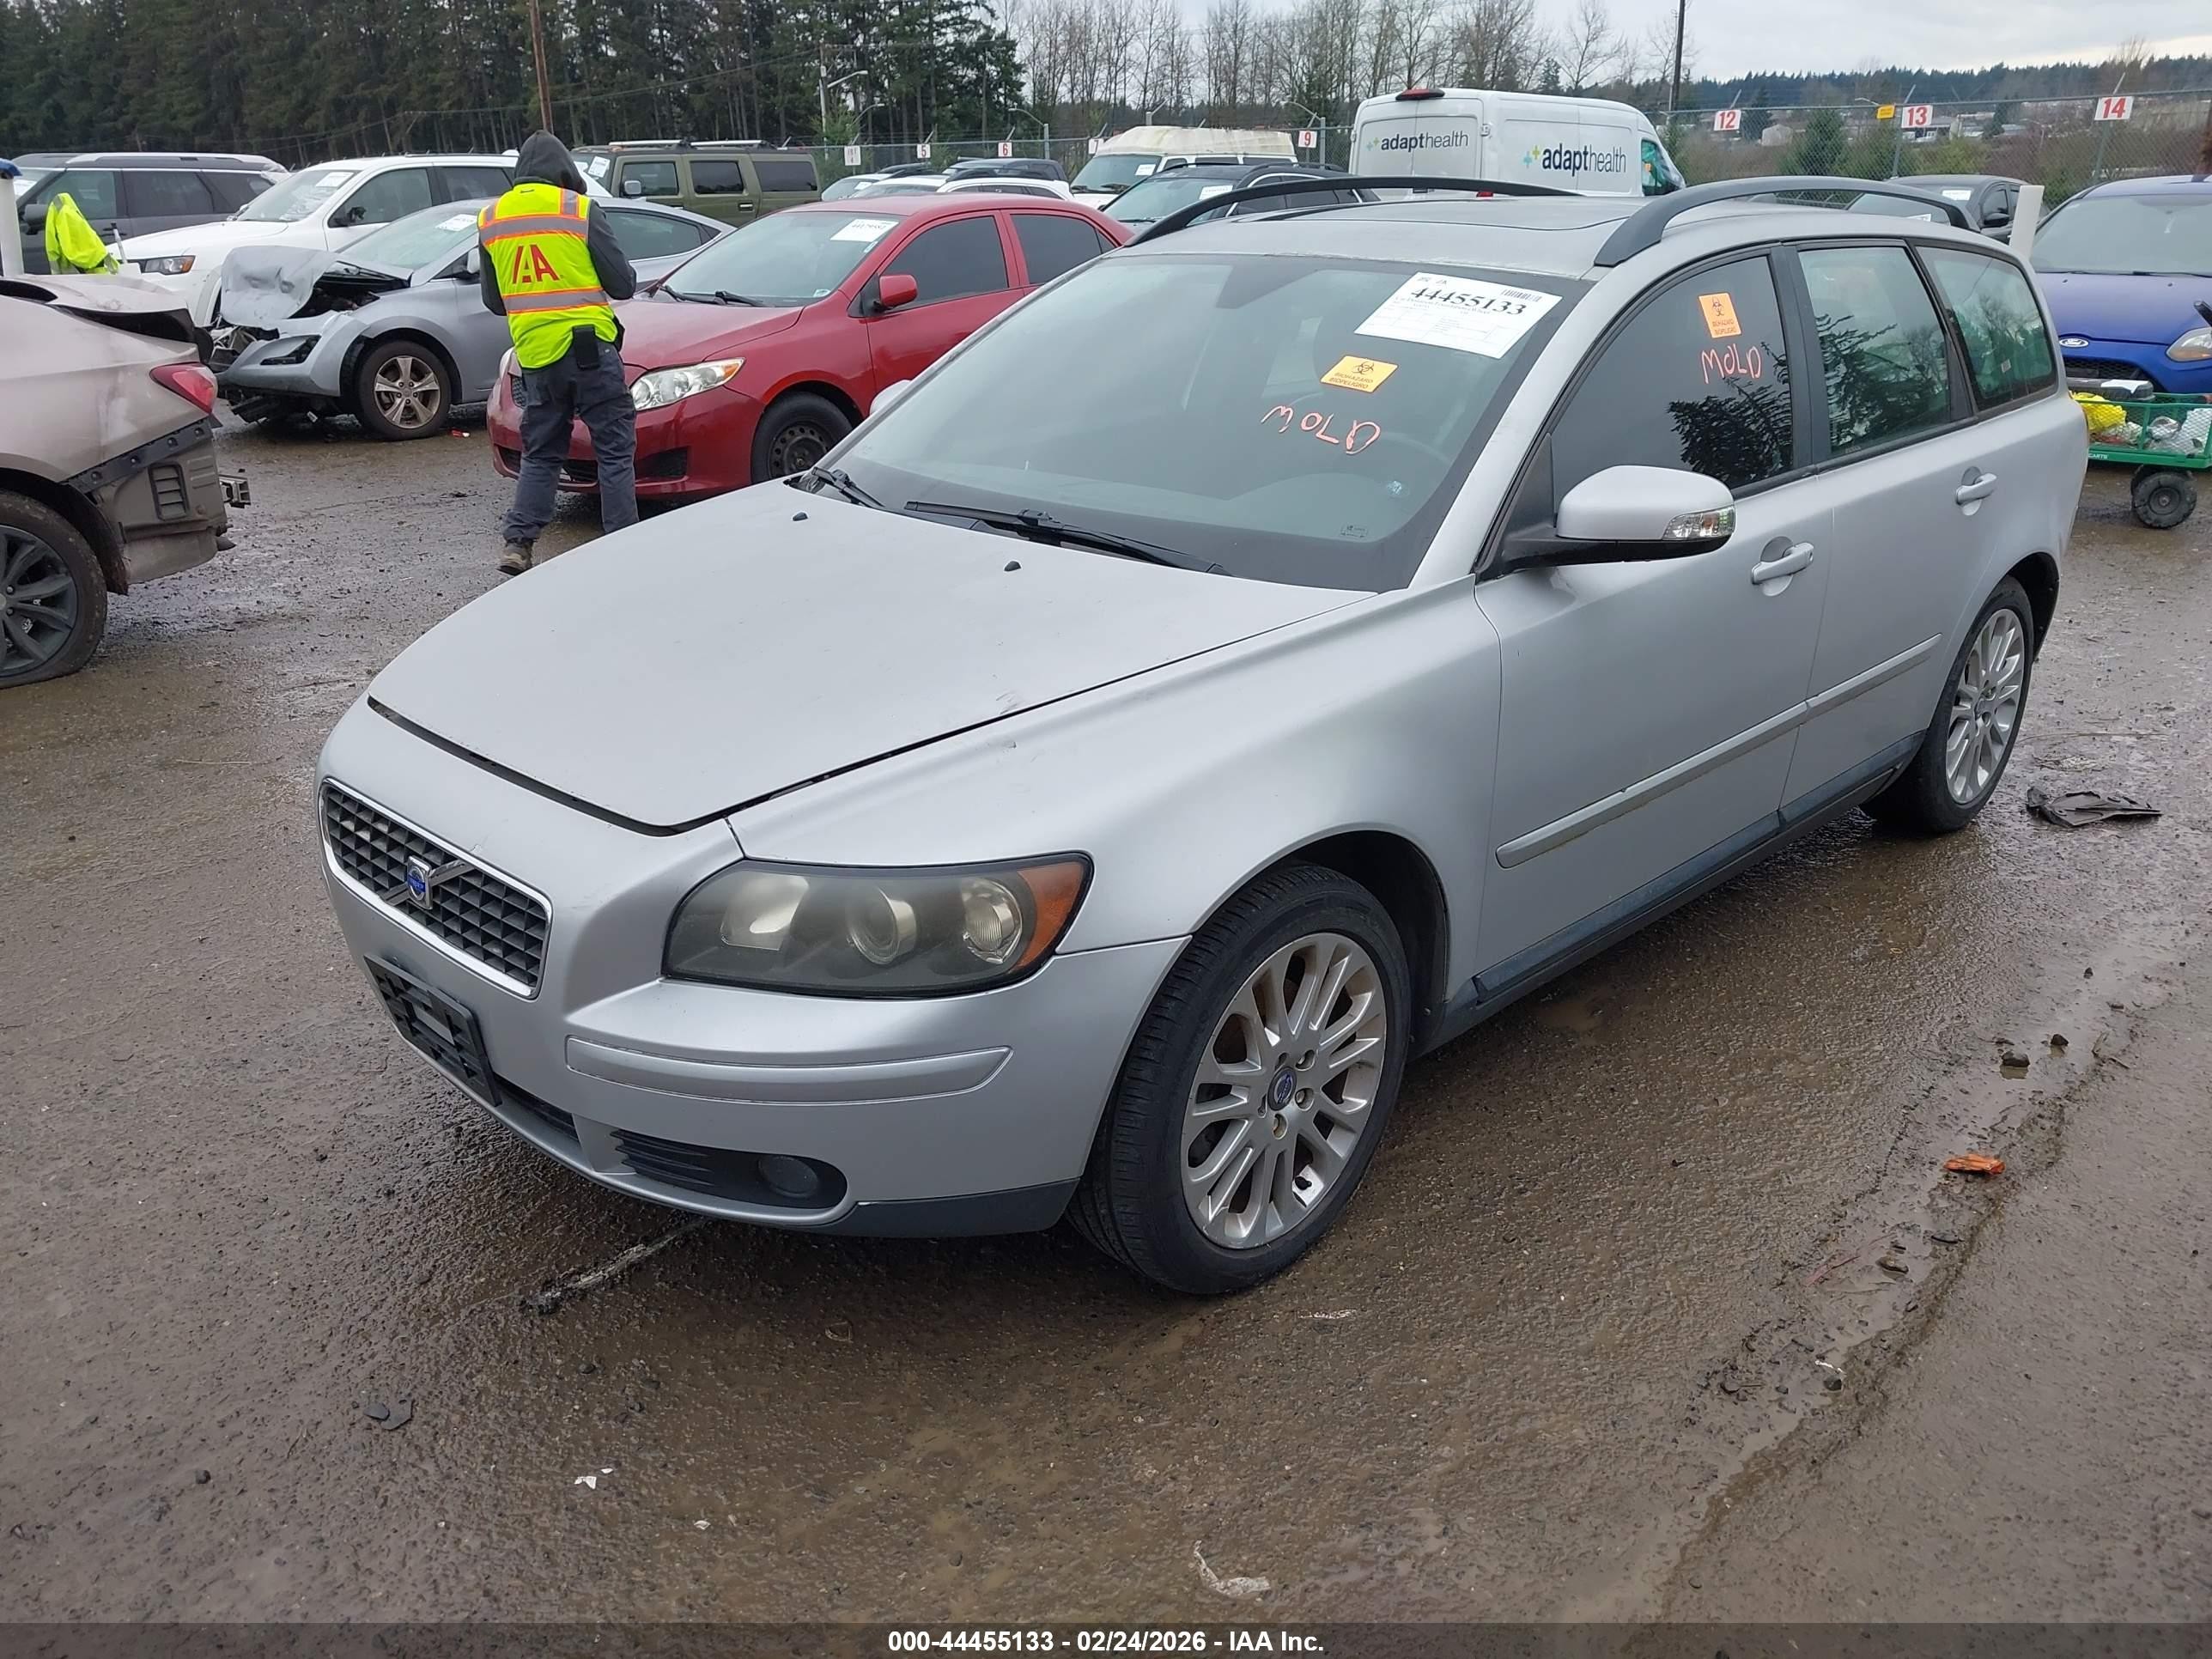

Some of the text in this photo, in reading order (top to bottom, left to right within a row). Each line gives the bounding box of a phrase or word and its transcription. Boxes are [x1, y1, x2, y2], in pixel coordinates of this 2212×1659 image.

[1907, 106, 1927, 126] 13
[2103, 98, 2126, 118] 14
[1718, 111, 1736, 129] 12
[1304, 131, 1311, 146] 9
[1381, 131, 1469, 153] adapthealth
[921, 144, 927, 157] 5
[1002, 143, 1008, 156] 6
[1541, 143, 1627, 177] adapthealth
[1411, 287, 1528, 316] 44455133
[1702, 343, 1761, 384] MOLD
[1260, 404, 1381, 454] MOLD
